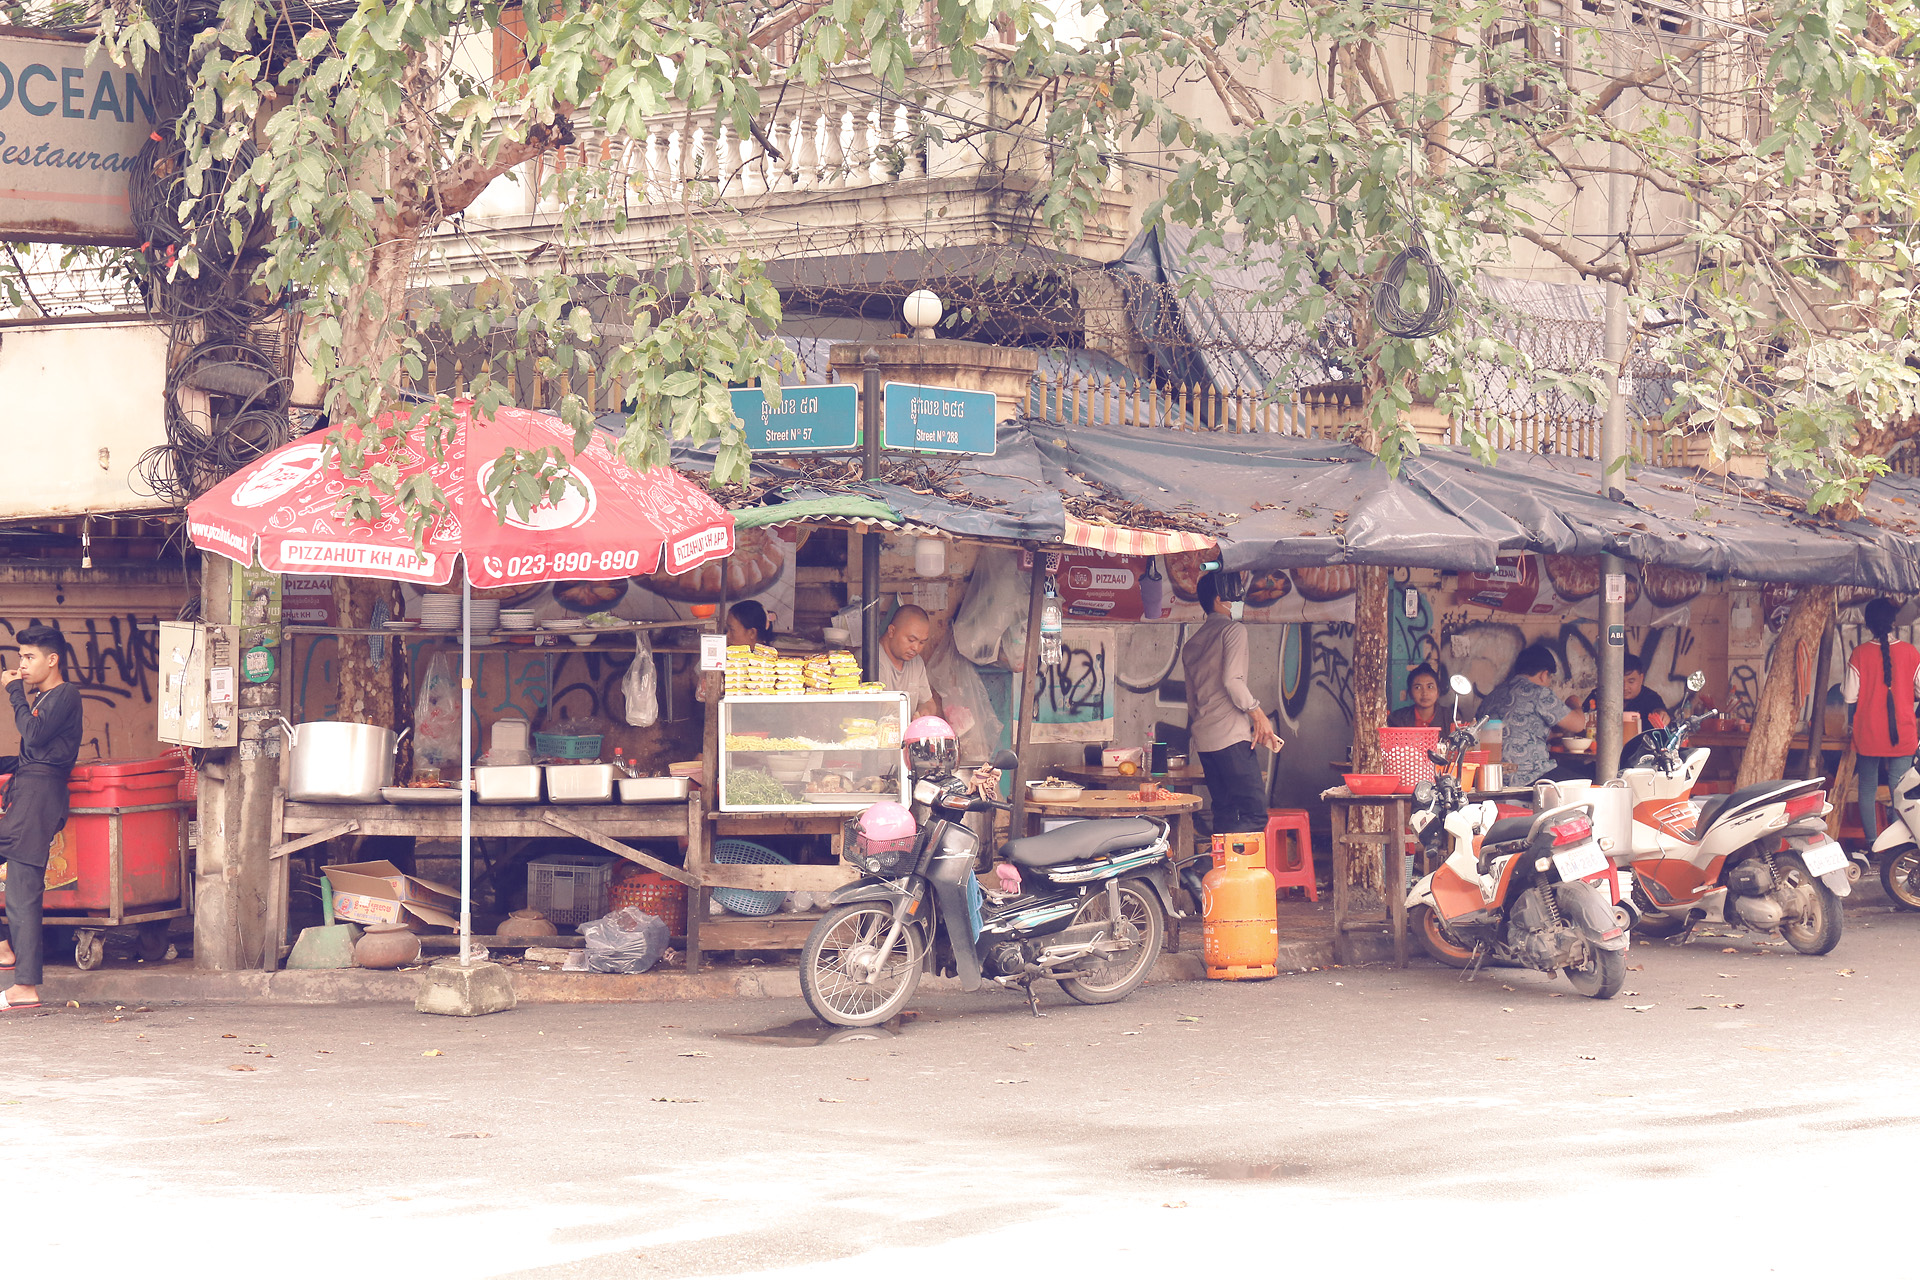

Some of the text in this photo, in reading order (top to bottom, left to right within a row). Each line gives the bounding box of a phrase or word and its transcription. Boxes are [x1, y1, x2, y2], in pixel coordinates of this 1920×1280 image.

[0, 130, 139, 173] estauran
[765, 429, 789, 442] Street
[803, 428, 812, 440] 57
[916, 429, 936, 442] Street
[947, 431, 959, 444] 288
[288, 545, 430, 571] PIZZAHUT KH APP
[507, 550, 640, 577] 023-890-890
[1095, 574, 1127, 584] PIZZA4U
